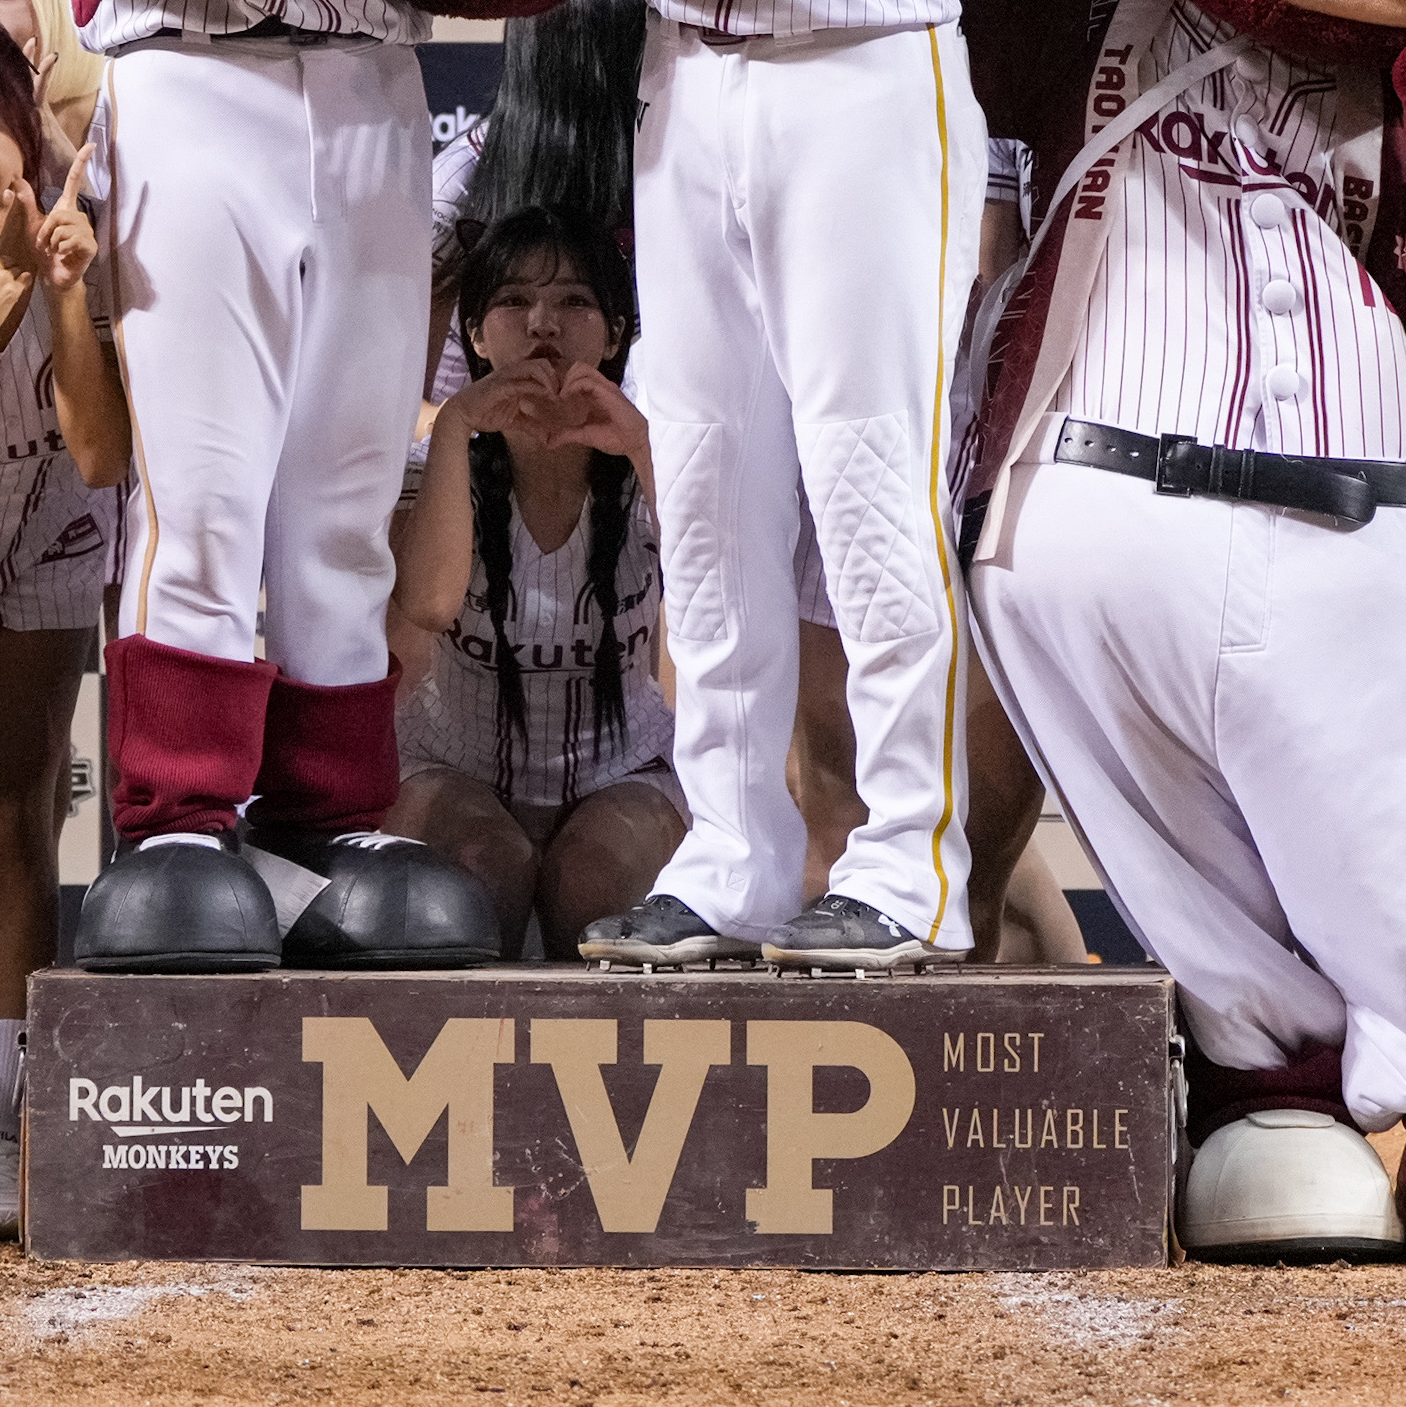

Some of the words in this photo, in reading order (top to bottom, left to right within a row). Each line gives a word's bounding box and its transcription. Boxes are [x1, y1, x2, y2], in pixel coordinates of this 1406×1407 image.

[1074, 44, 1135, 221] TAOUAN
[943, 1032, 1045, 1073] MOST
[68, 1075, 274, 1124] Rakuten
[300, 1017, 916, 1234] MVP
[942, 1108, 1130, 1150] VALUABLE
[102, 1144, 240, 1171] MONKEYS
[943, 1185, 1082, 1227] PLAYER
